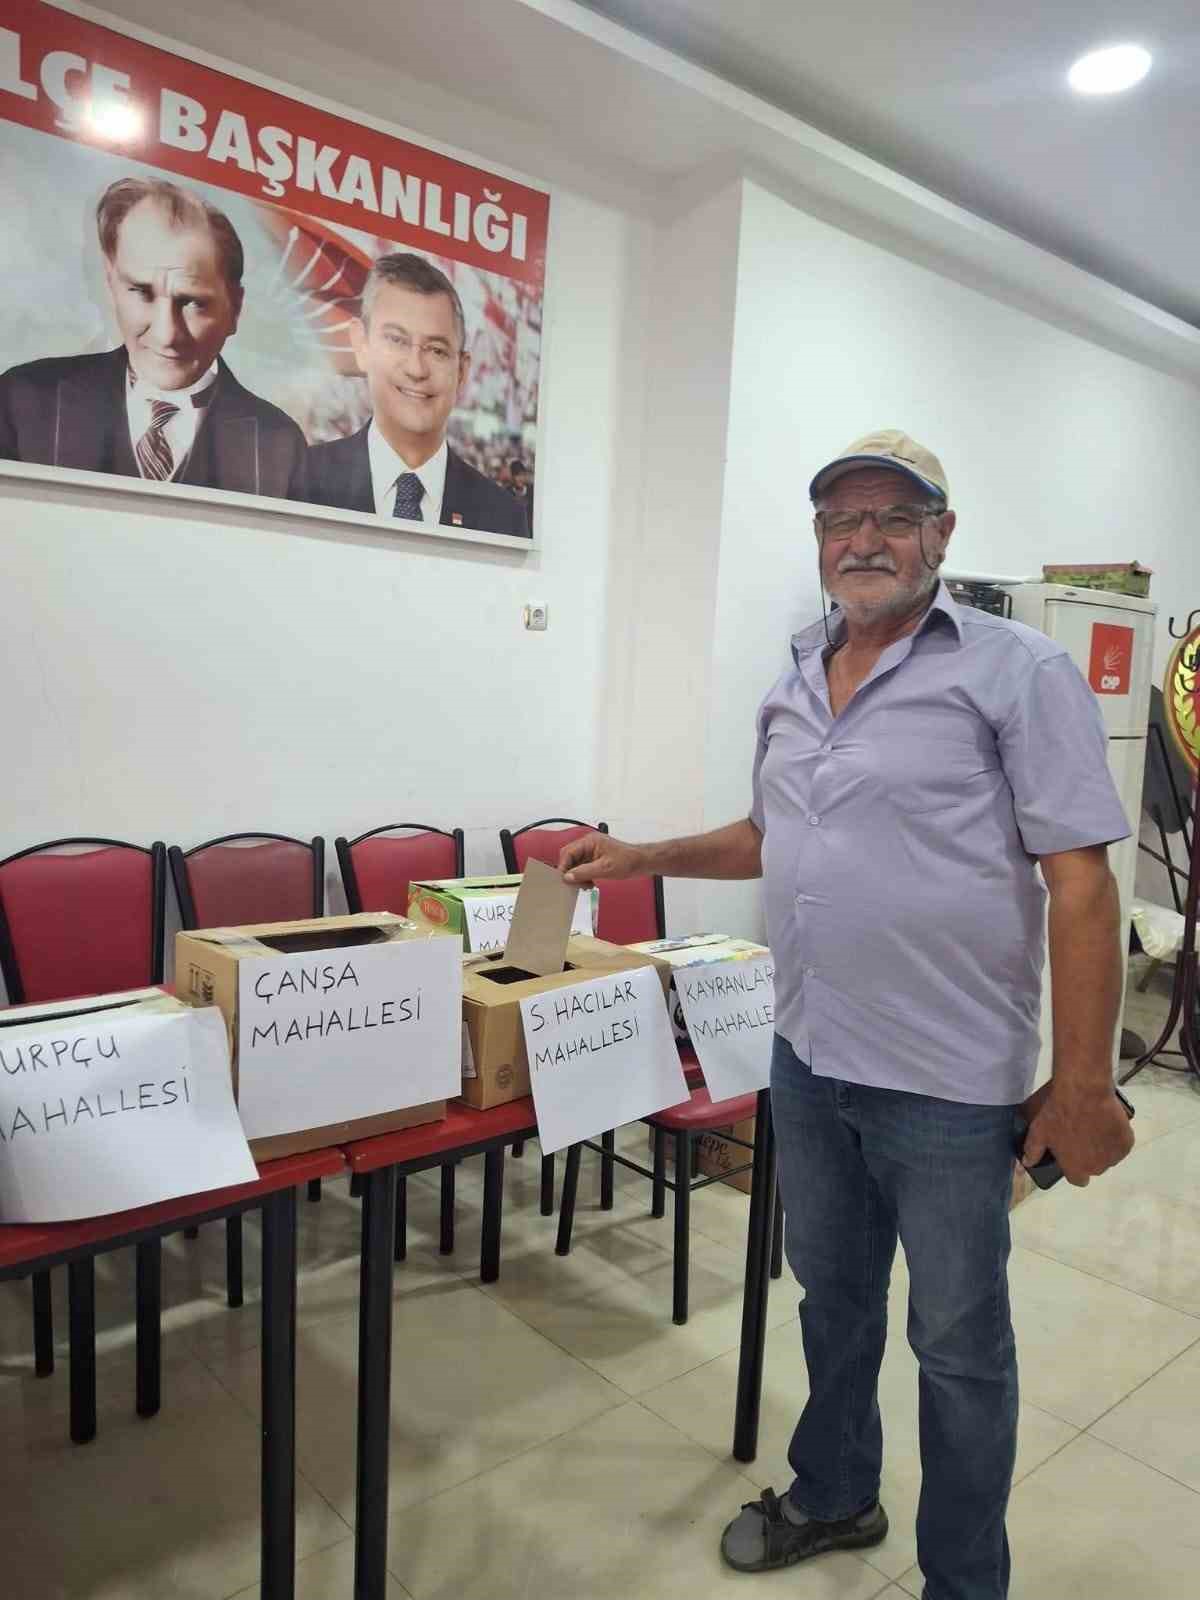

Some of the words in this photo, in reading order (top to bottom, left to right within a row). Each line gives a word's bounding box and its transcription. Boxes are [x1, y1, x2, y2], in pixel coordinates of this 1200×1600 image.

[160, 88, 528, 261] BAŞKANLIĞI
[254, 961, 360, 1004] ÇANŞA
[554, 981, 638, 1024] HACILAR
[686, 964, 776, 1002] KAYRANLAR
[252, 987, 422, 1048] MAHALLESİ
[535, 1009, 640, 1072] MAHALLESİ
[0, 1035, 121, 1076] URPÇU
[0, 1065, 190, 1142] AHALLESİ
